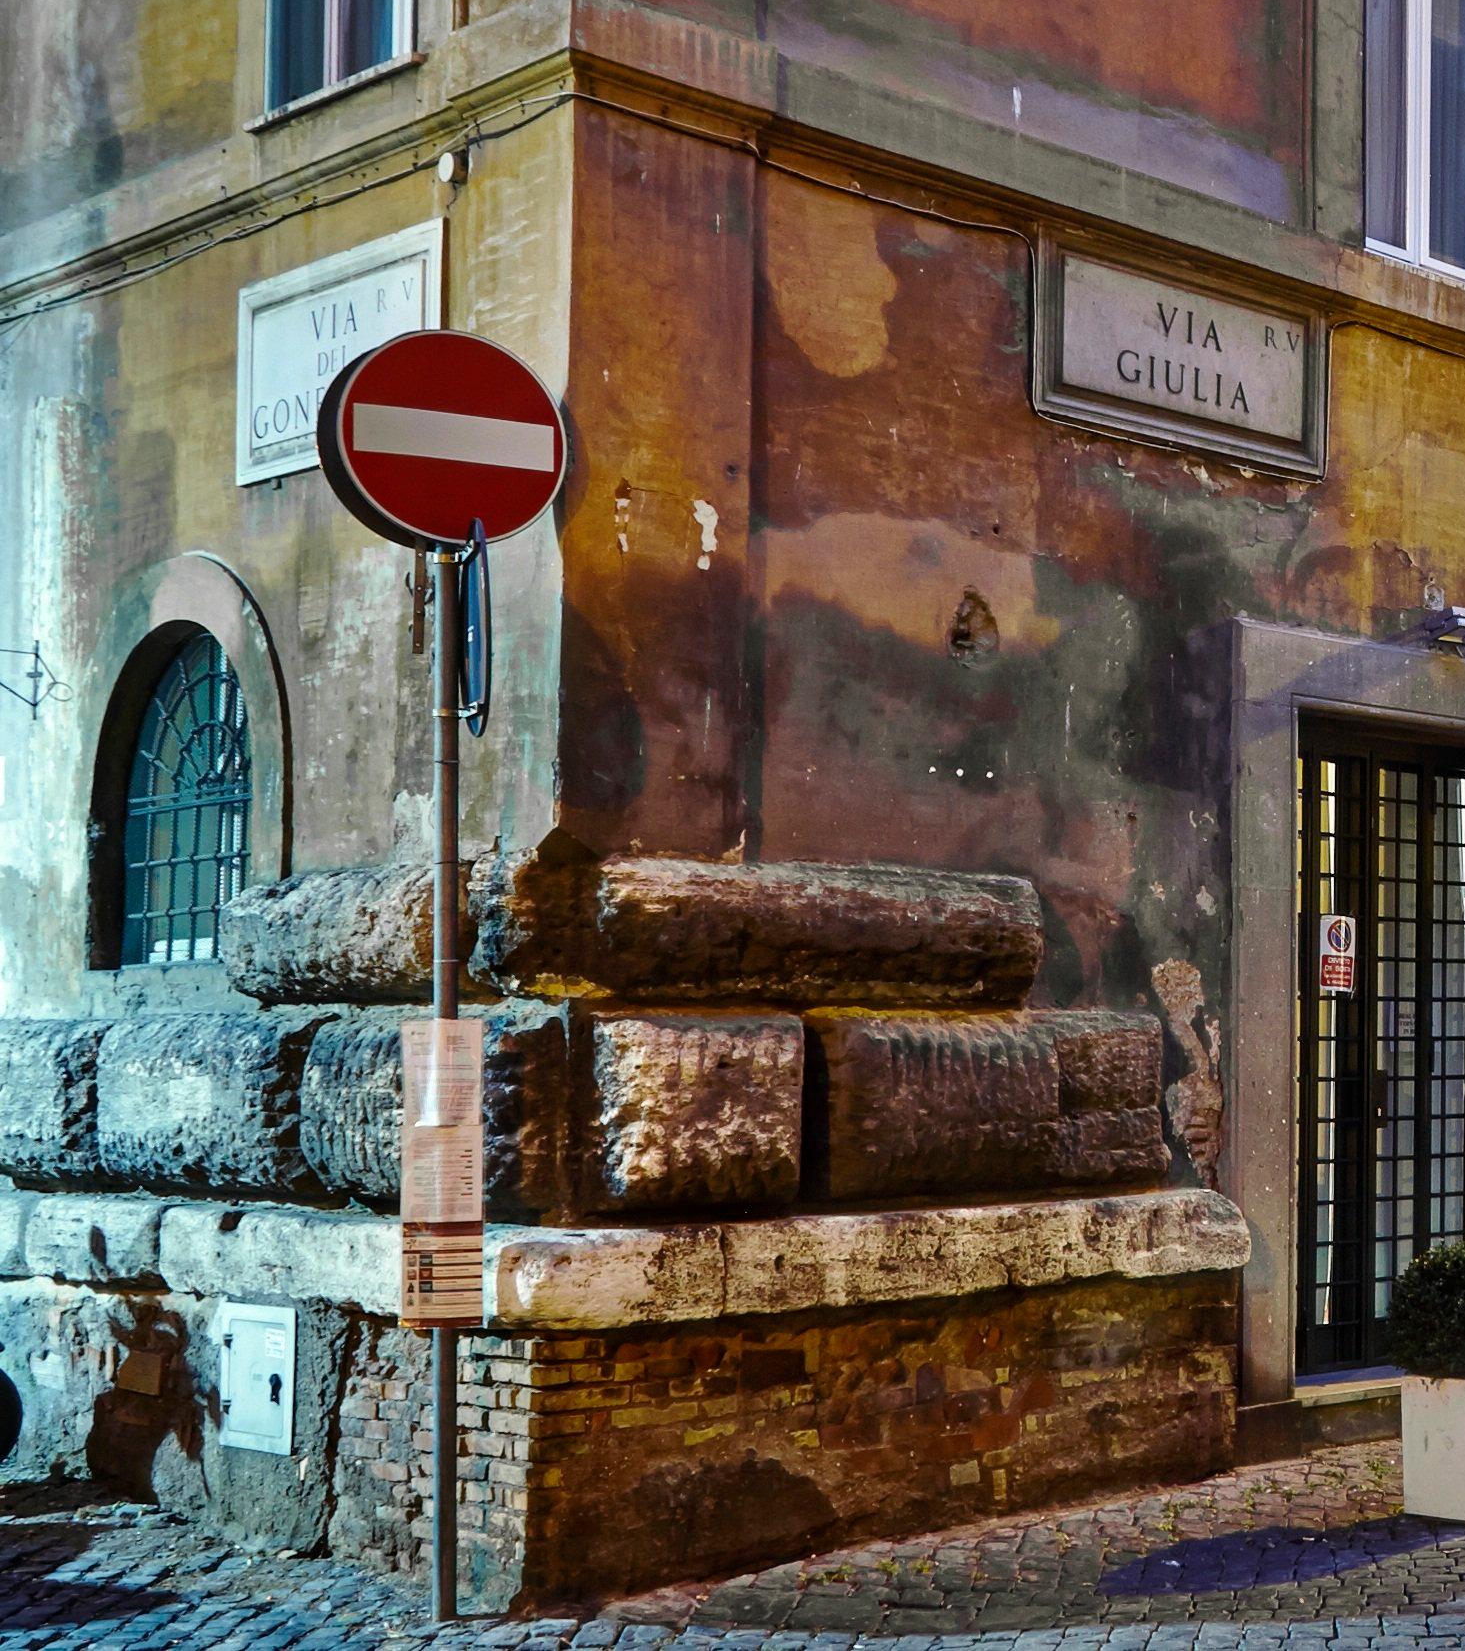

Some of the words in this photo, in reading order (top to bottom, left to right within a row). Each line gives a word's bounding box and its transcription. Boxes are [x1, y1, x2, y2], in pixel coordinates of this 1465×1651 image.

[310, 301, 358, 340] VIA
[1156, 302, 1223, 353] VIA
[1116, 349, 1250, 414] GIULIA
